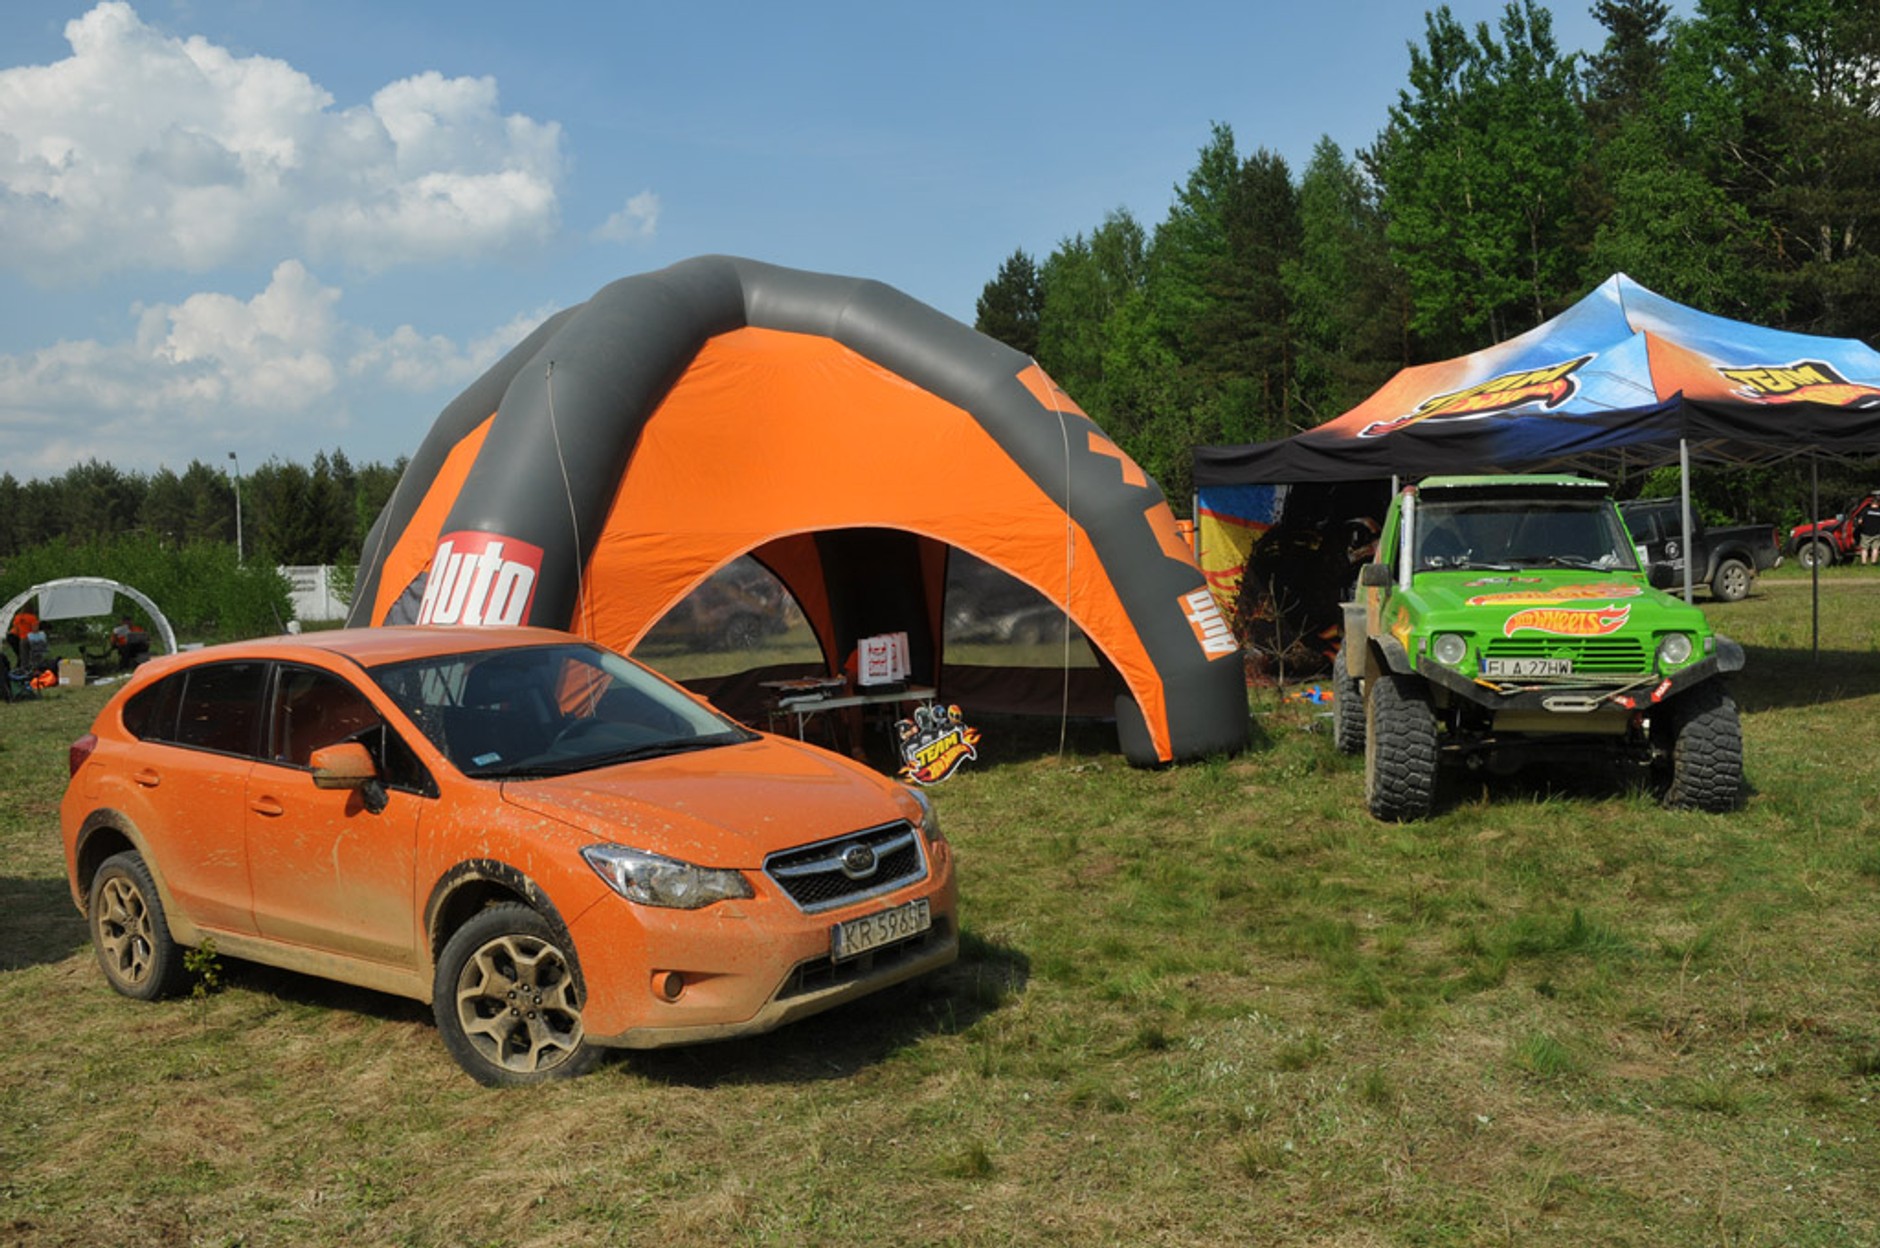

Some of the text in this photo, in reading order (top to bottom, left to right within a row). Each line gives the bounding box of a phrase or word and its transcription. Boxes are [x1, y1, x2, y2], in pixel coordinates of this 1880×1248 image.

[416, 541, 535, 625] Auto
[915, 732, 958, 767] TEAM
[845, 920, 872, 953] KR
